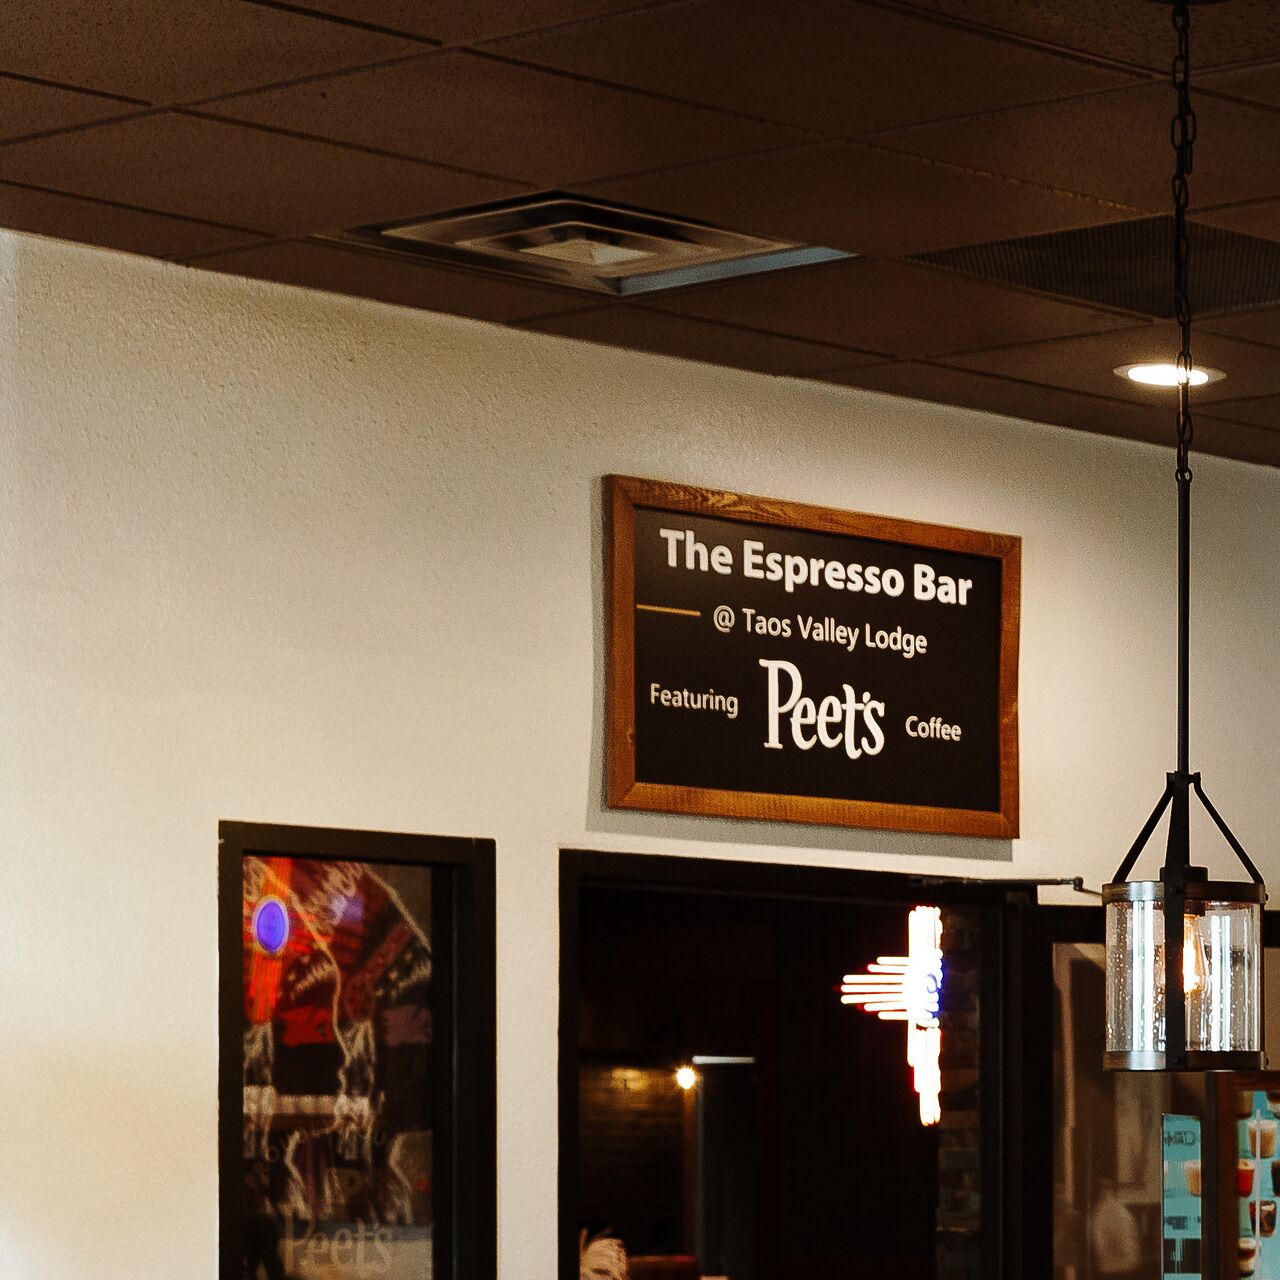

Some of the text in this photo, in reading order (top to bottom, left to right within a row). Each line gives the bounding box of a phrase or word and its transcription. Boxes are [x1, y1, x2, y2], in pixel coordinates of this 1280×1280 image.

[660, 528, 972, 606] The Espresso Bar
[713, 605, 928, 659] @ Taos Valley Lodge
[650, 659, 962, 759] Featuring Peet's Coffee
